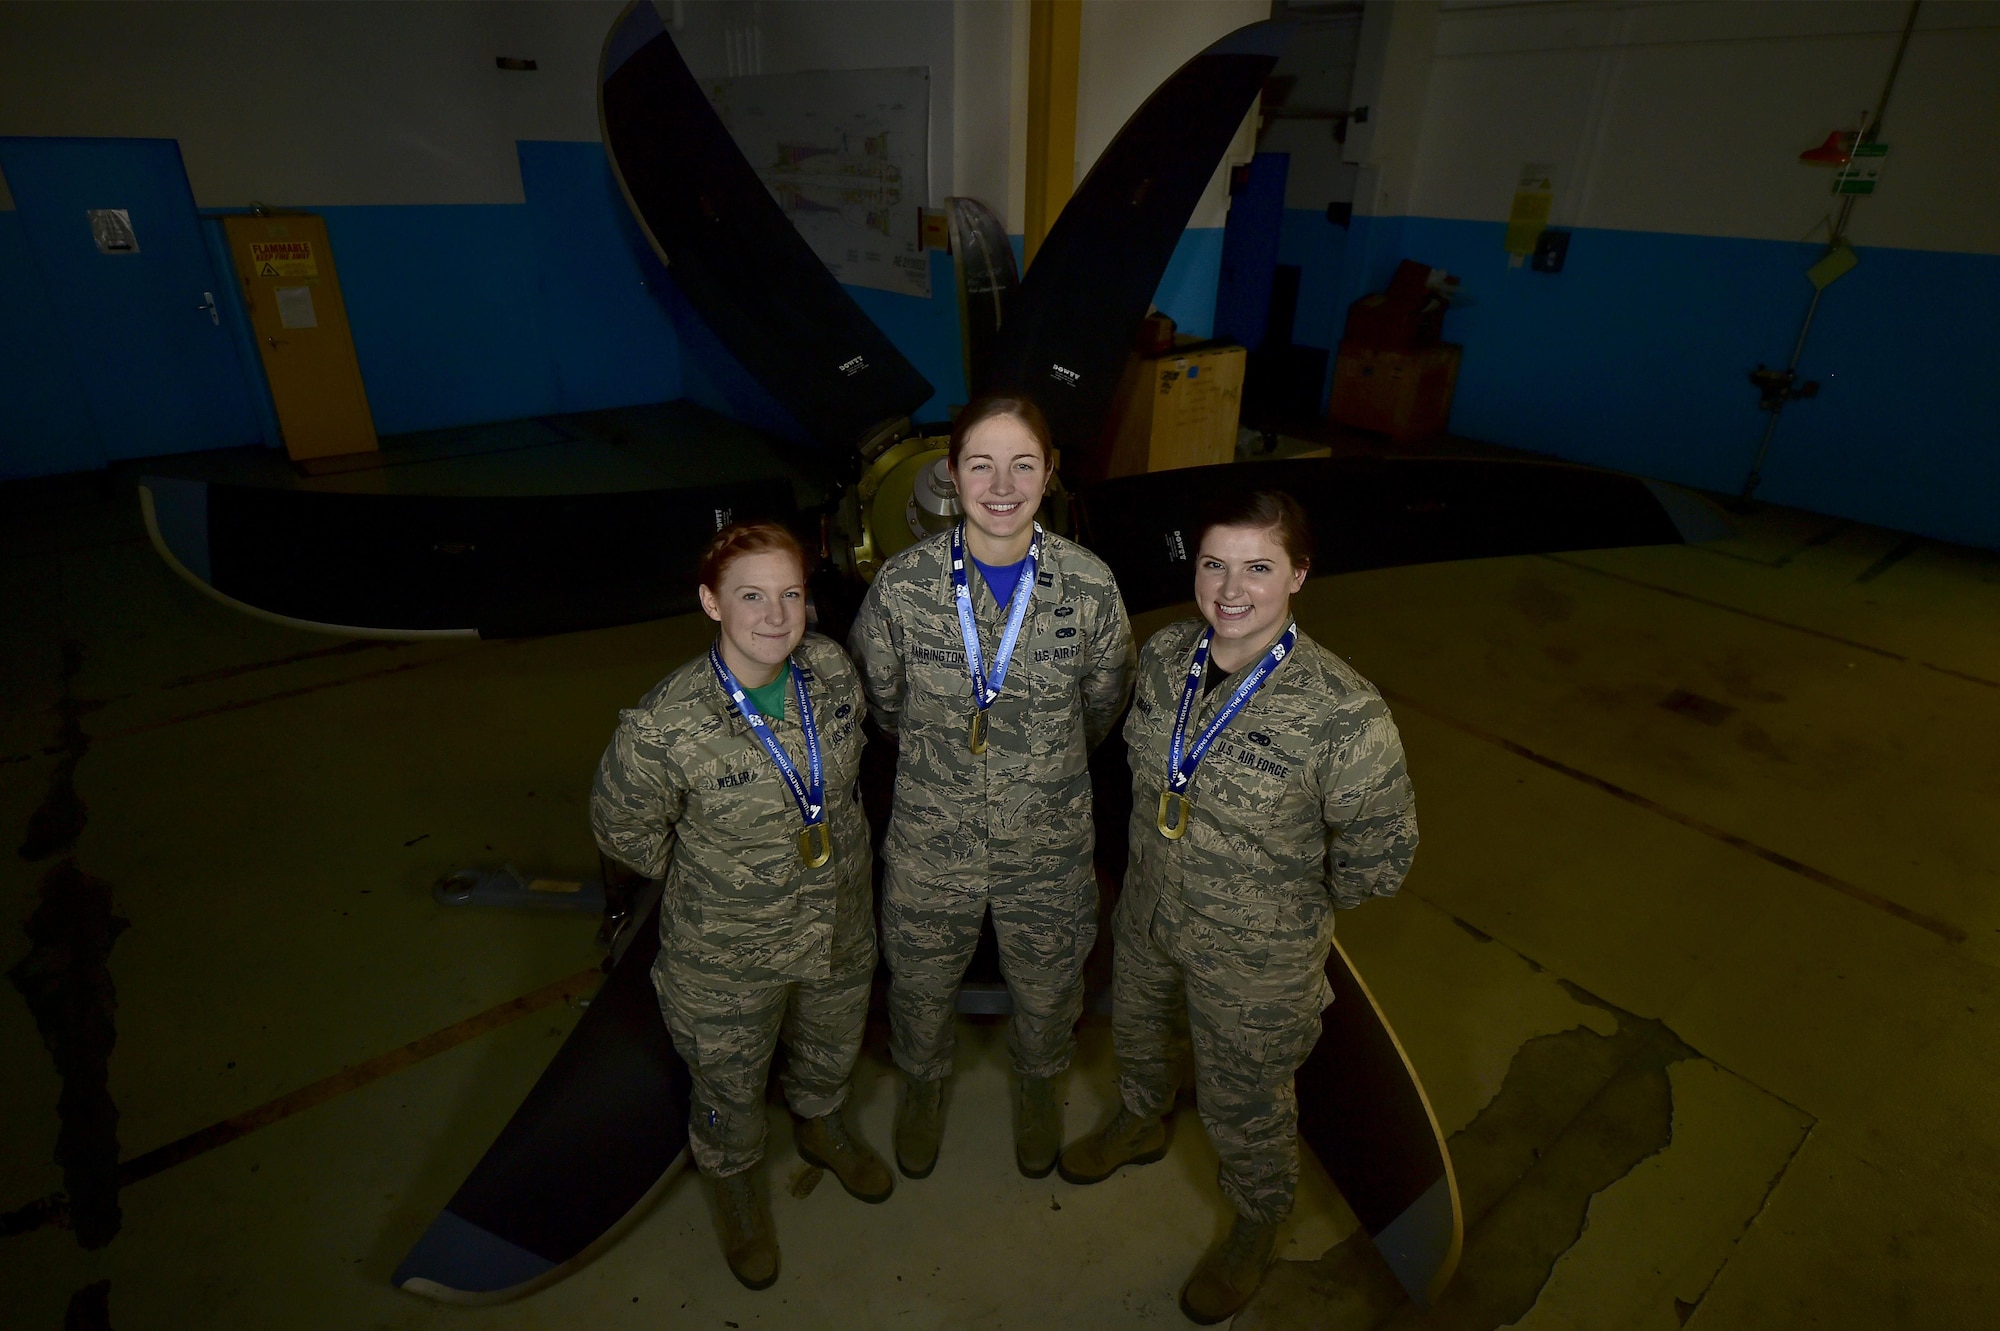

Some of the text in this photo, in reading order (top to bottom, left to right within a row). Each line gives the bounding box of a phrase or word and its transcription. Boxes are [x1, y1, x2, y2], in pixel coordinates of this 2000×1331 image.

[252, 243, 310, 255] FLAMMABLE
[839, 356, 863, 370] DOWTY
[1053, 364, 1080, 379] DOWTY
[1174, 531, 1186, 560] DOWTY
[996, 651, 1007, 673] ATHENS
[1014, 603, 1022, 616] THE
[1018, 570, 1032, 604] AUTHENTIC
[1035, 650, 1051, 661] U.S.
[1053, 648, 1069, 660] AIR
[797, 680, 808, 714] AUTHENTIC
[1173, 724, 1183, 755] ATHLETICS
[1179, 688, 1192, 723] FEDERATION
[1192, 738, 1208, 760] ATHENS
[1230, 696, 1243, 709] THE
[1241, 667, 1266, 699] AUTHENTIC
[1218, 740, 1288, 779] U.S. AIR FORCE
[717, 771, 750, 789] WEILER
[766, 736, 809, 816] ELLENIC ATHLETICS FEDERATION
